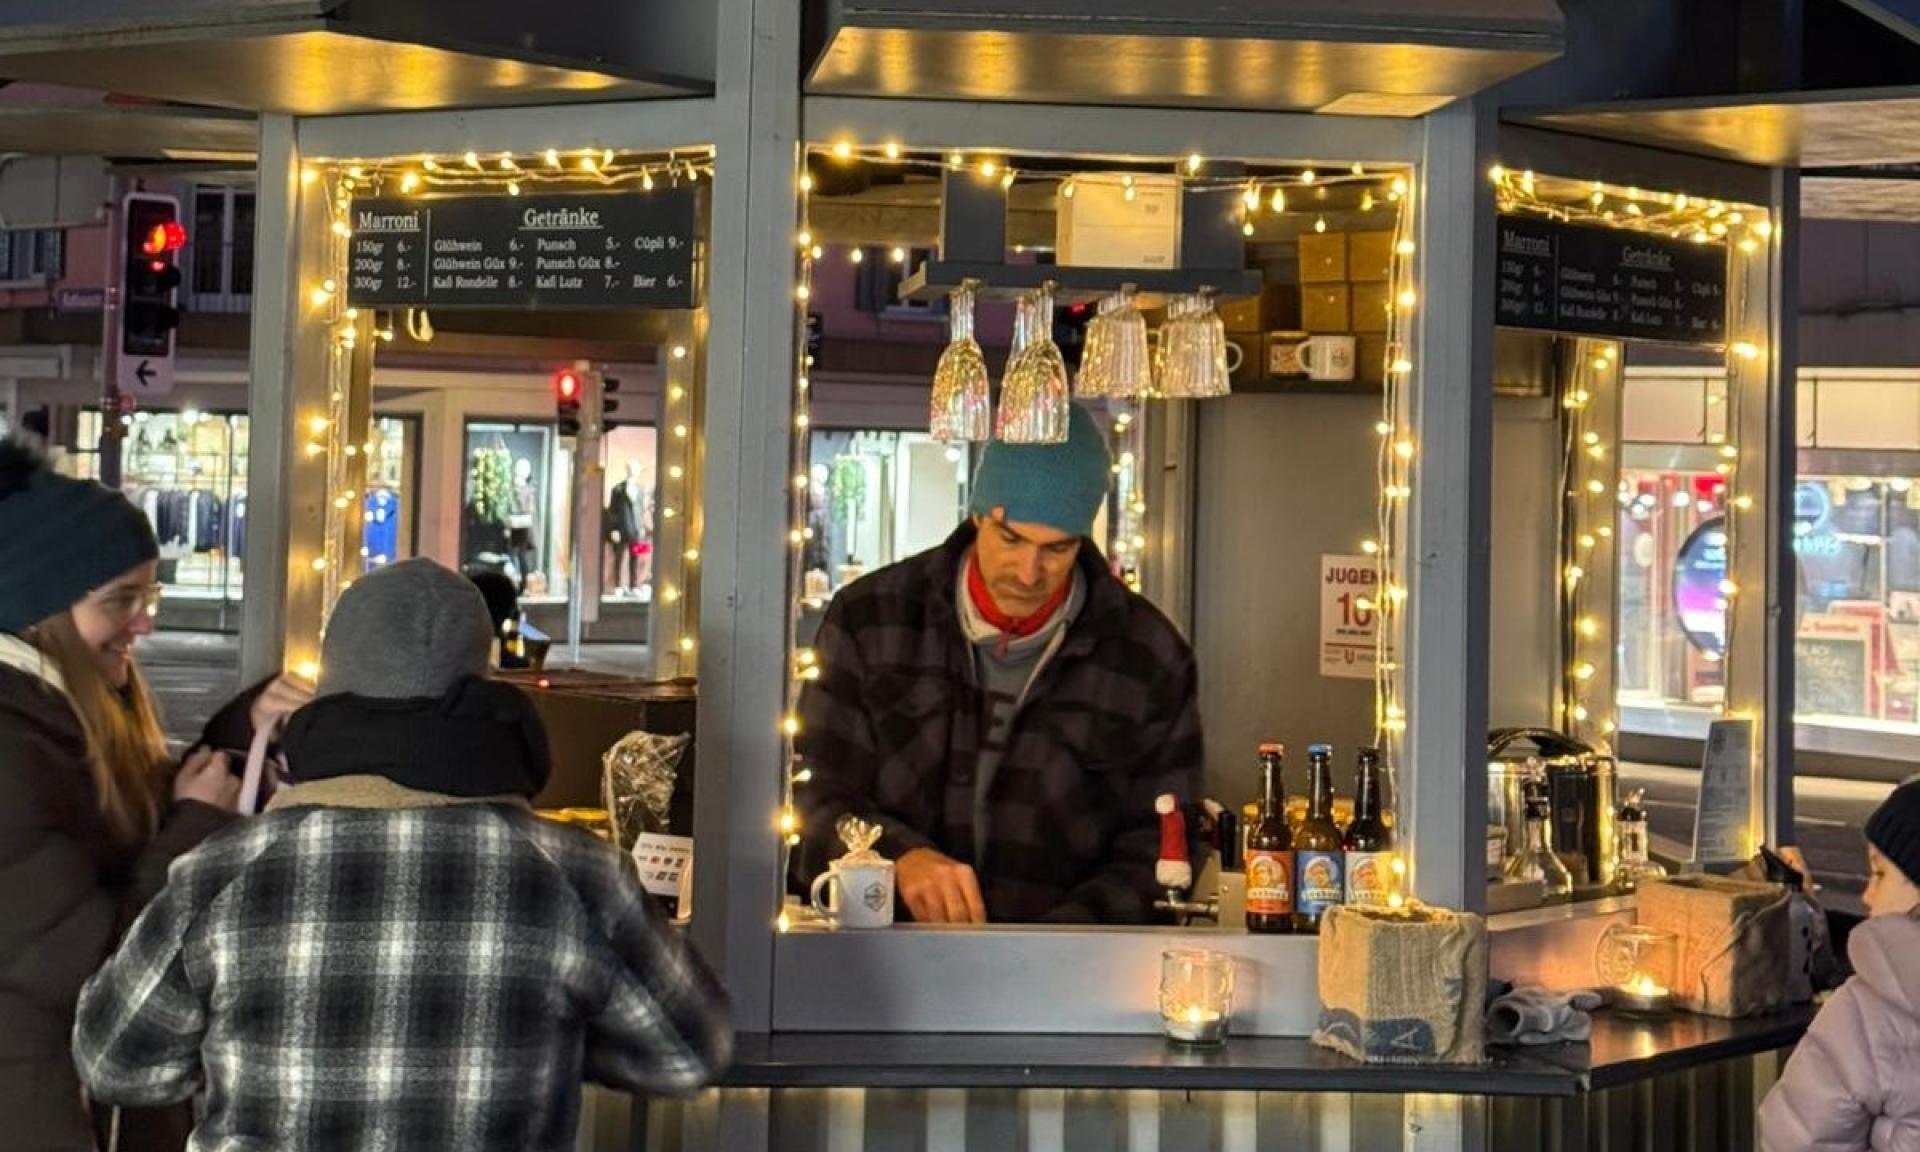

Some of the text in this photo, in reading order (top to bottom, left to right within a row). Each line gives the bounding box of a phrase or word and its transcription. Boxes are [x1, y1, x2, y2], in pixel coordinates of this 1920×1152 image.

[358, 209, 419, 230] Marroni
[523, 206, 600, 227] Getränke
[356, 240, 385, 256] 150gr
[434, 239, 483, 251] Glühwein
[537, 237, 577, 250] Punsch
[634, 236, 665, 253] Cüpli
[355, 258, 384, 273] 200gr
[433, 257, 481, 270] Glühwein
[536, 256, 576, 270] Punsch
[354, 275, 383, 291] 300gr
[455, 275, 499, 288] Rondelle
[559, 275, 583, 288] Lutz
[633, 274, 657, 288] Bier
[1325, 567, 1389, 585] JUGEN
